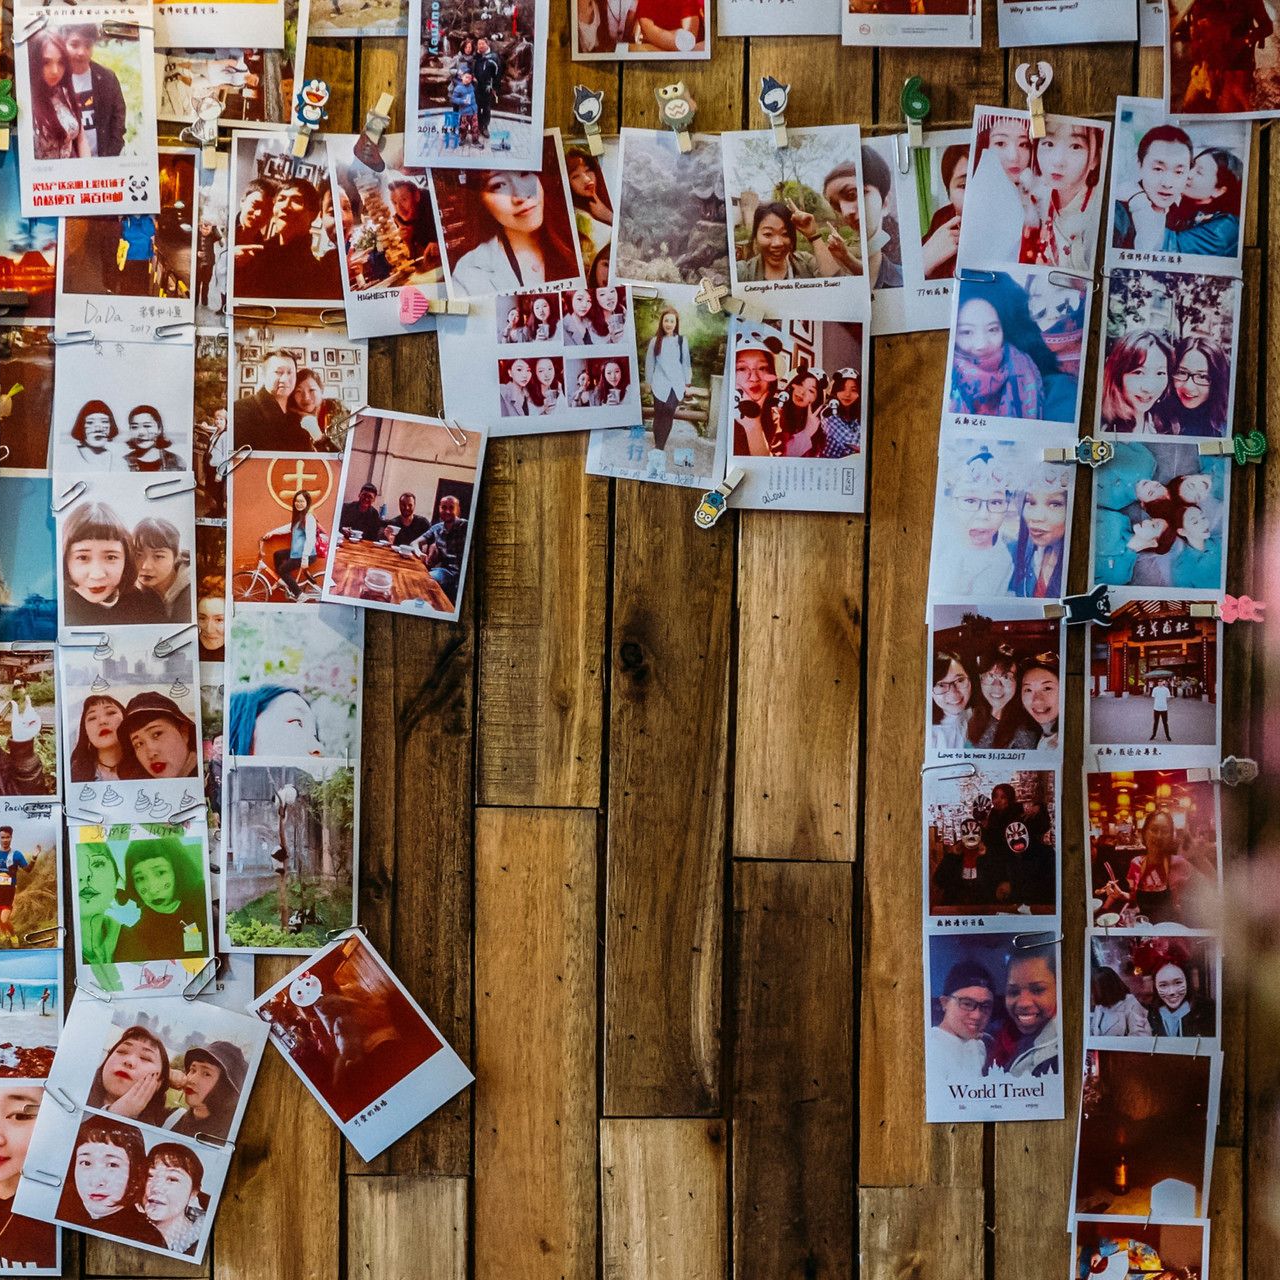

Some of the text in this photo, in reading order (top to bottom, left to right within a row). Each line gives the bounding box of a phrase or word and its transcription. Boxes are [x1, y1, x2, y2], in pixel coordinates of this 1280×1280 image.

[744, 284, 773, 294] Chengdu
[773, 283, 794, 291] Panda
[948, 1082, 1044, 1099] World Travel
